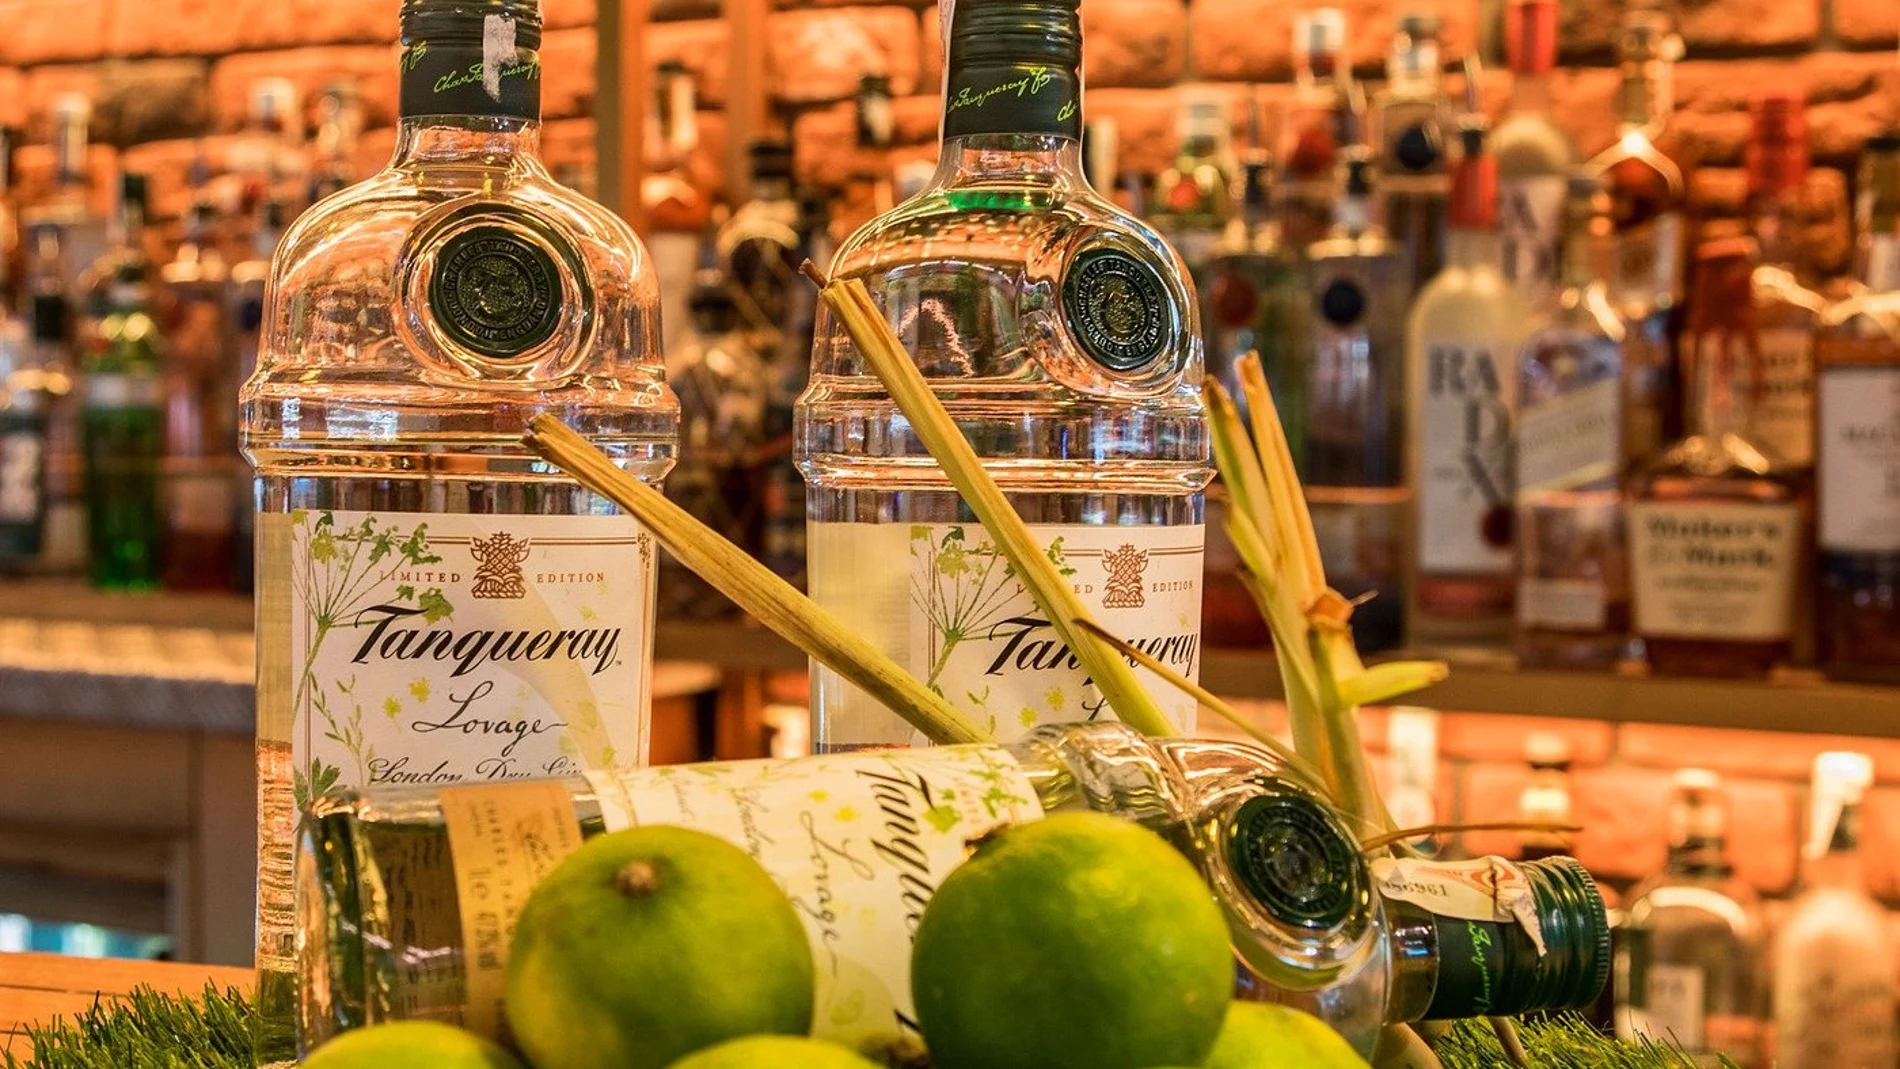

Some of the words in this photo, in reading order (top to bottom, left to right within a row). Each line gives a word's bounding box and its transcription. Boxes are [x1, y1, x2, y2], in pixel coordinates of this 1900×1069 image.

[379, 571, 461, 584] LIMITED
[536, 571, 606, 584] EDITION
[1152, 580, 1194, 592] EDITION
[351, 604, 621, 678] Tanqueray
[984, 616, 1199, 679] Tanueray
[411, 680, 569, 757] Lovage
[368, 756, 464, 785] London
